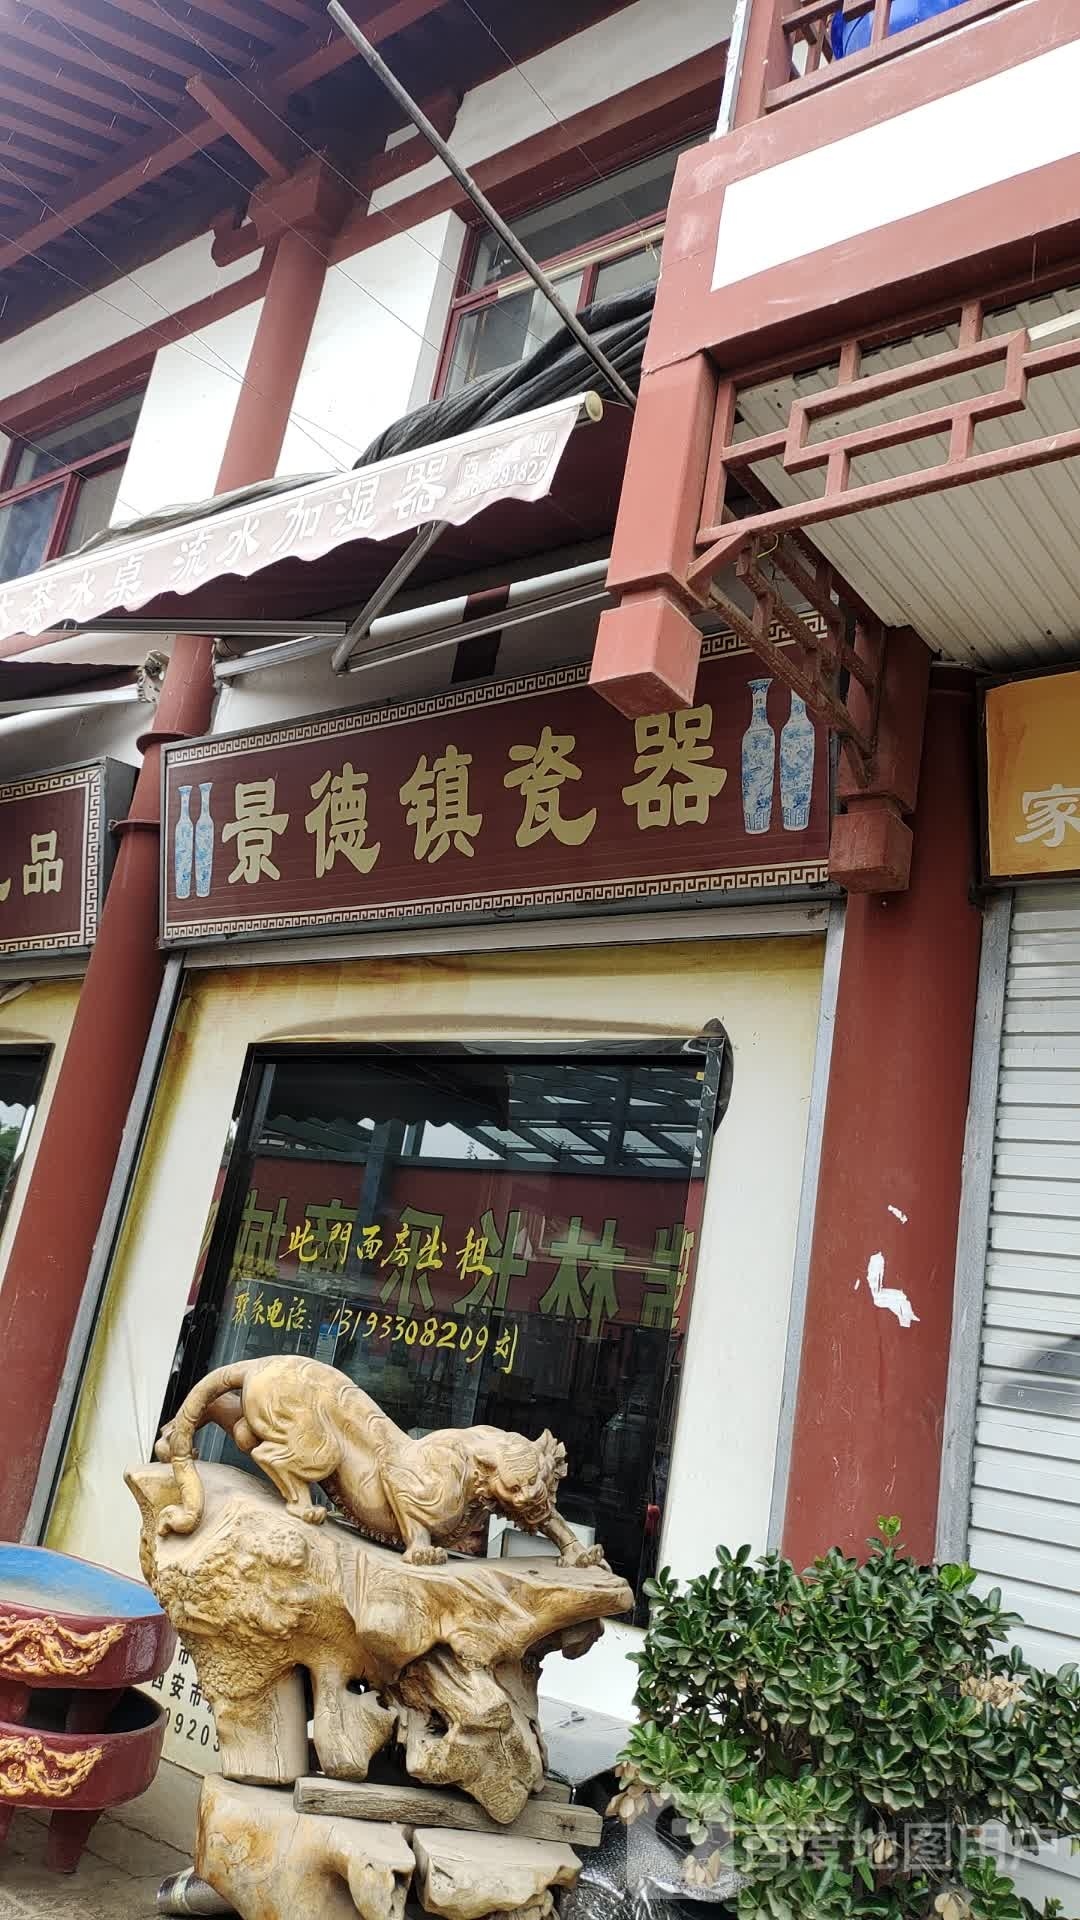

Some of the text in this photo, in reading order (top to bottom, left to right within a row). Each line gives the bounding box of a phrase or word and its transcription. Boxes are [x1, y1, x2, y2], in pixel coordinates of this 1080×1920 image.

[221, 704, 727, 885] 景德镇瓷器
[1014, 783, 1080, 848] 家
[0, 830, 63, 901] 品
